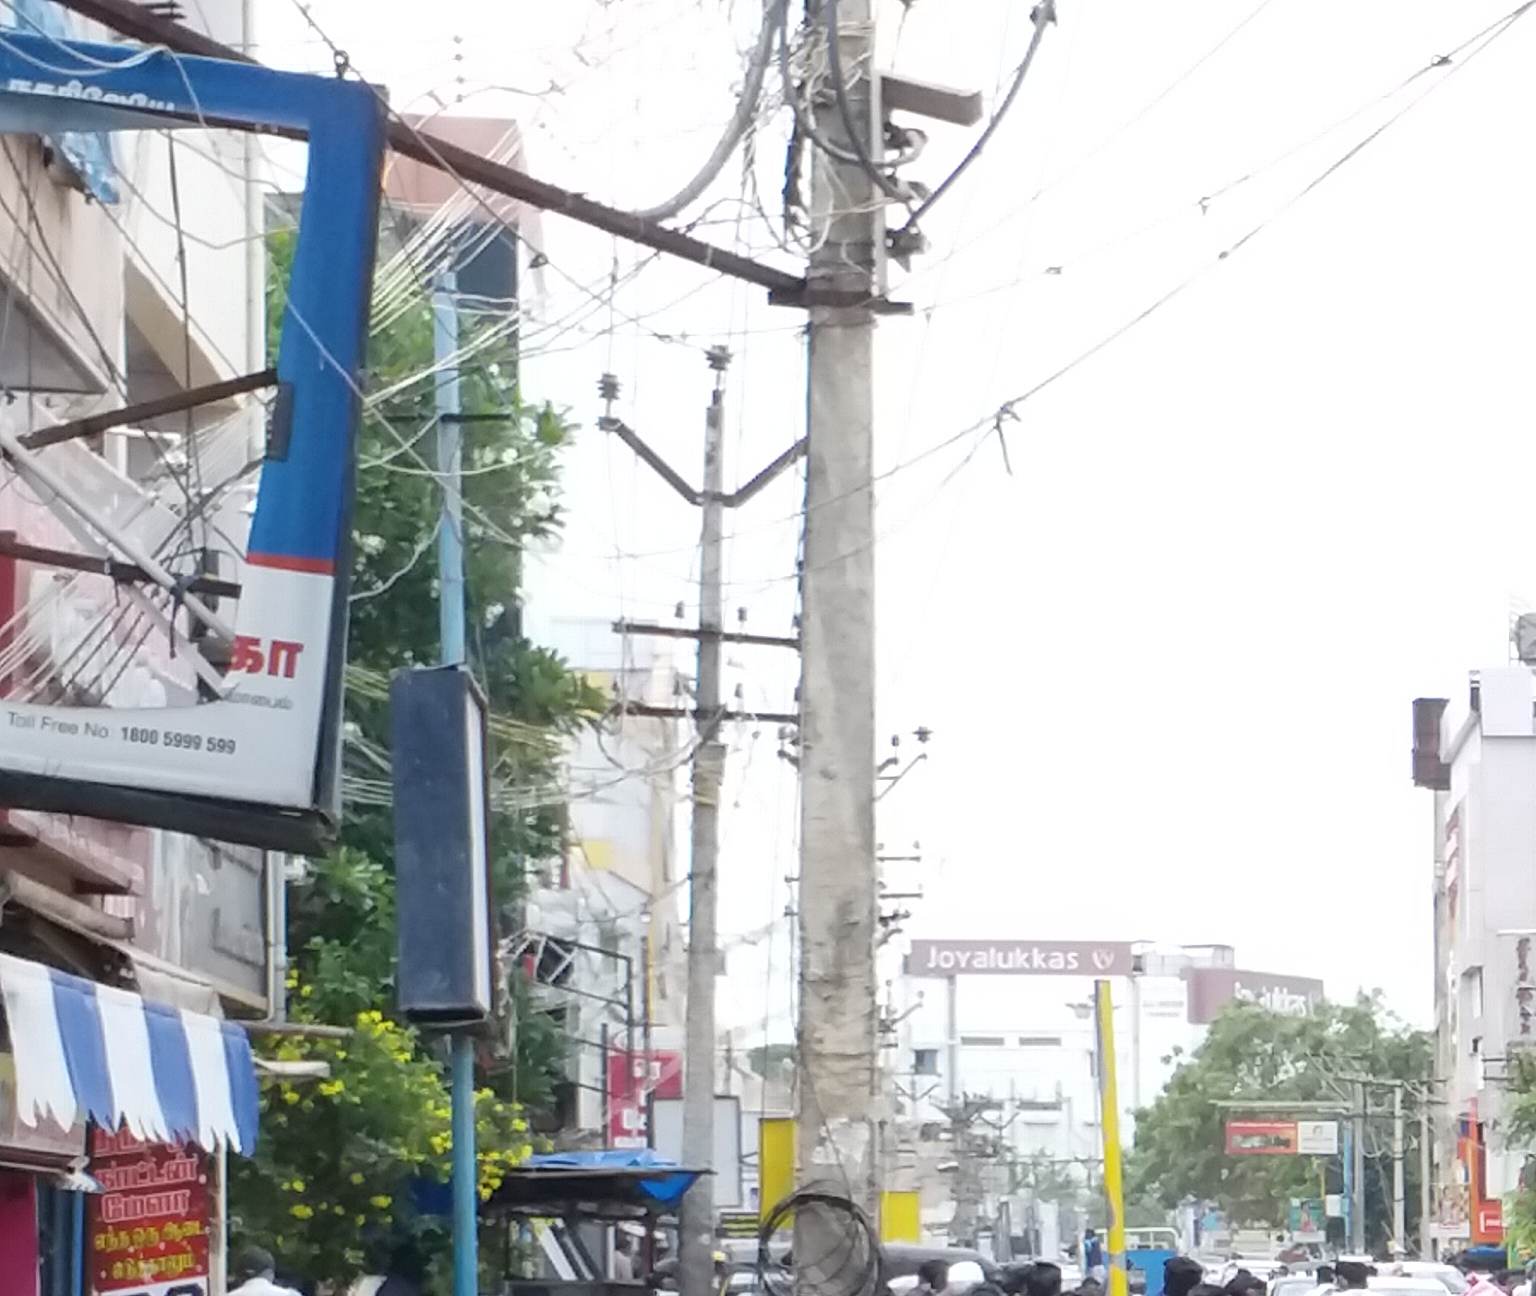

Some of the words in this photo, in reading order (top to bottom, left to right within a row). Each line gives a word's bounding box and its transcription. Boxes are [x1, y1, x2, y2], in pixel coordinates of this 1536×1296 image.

[7, 711, 35, 729] Toll
[40, 716, 79, 736] Free
[119, 726, 160, 747] 1800
[161, 730, 203, 752] 5999
[206, 737, 238, 756] 599
